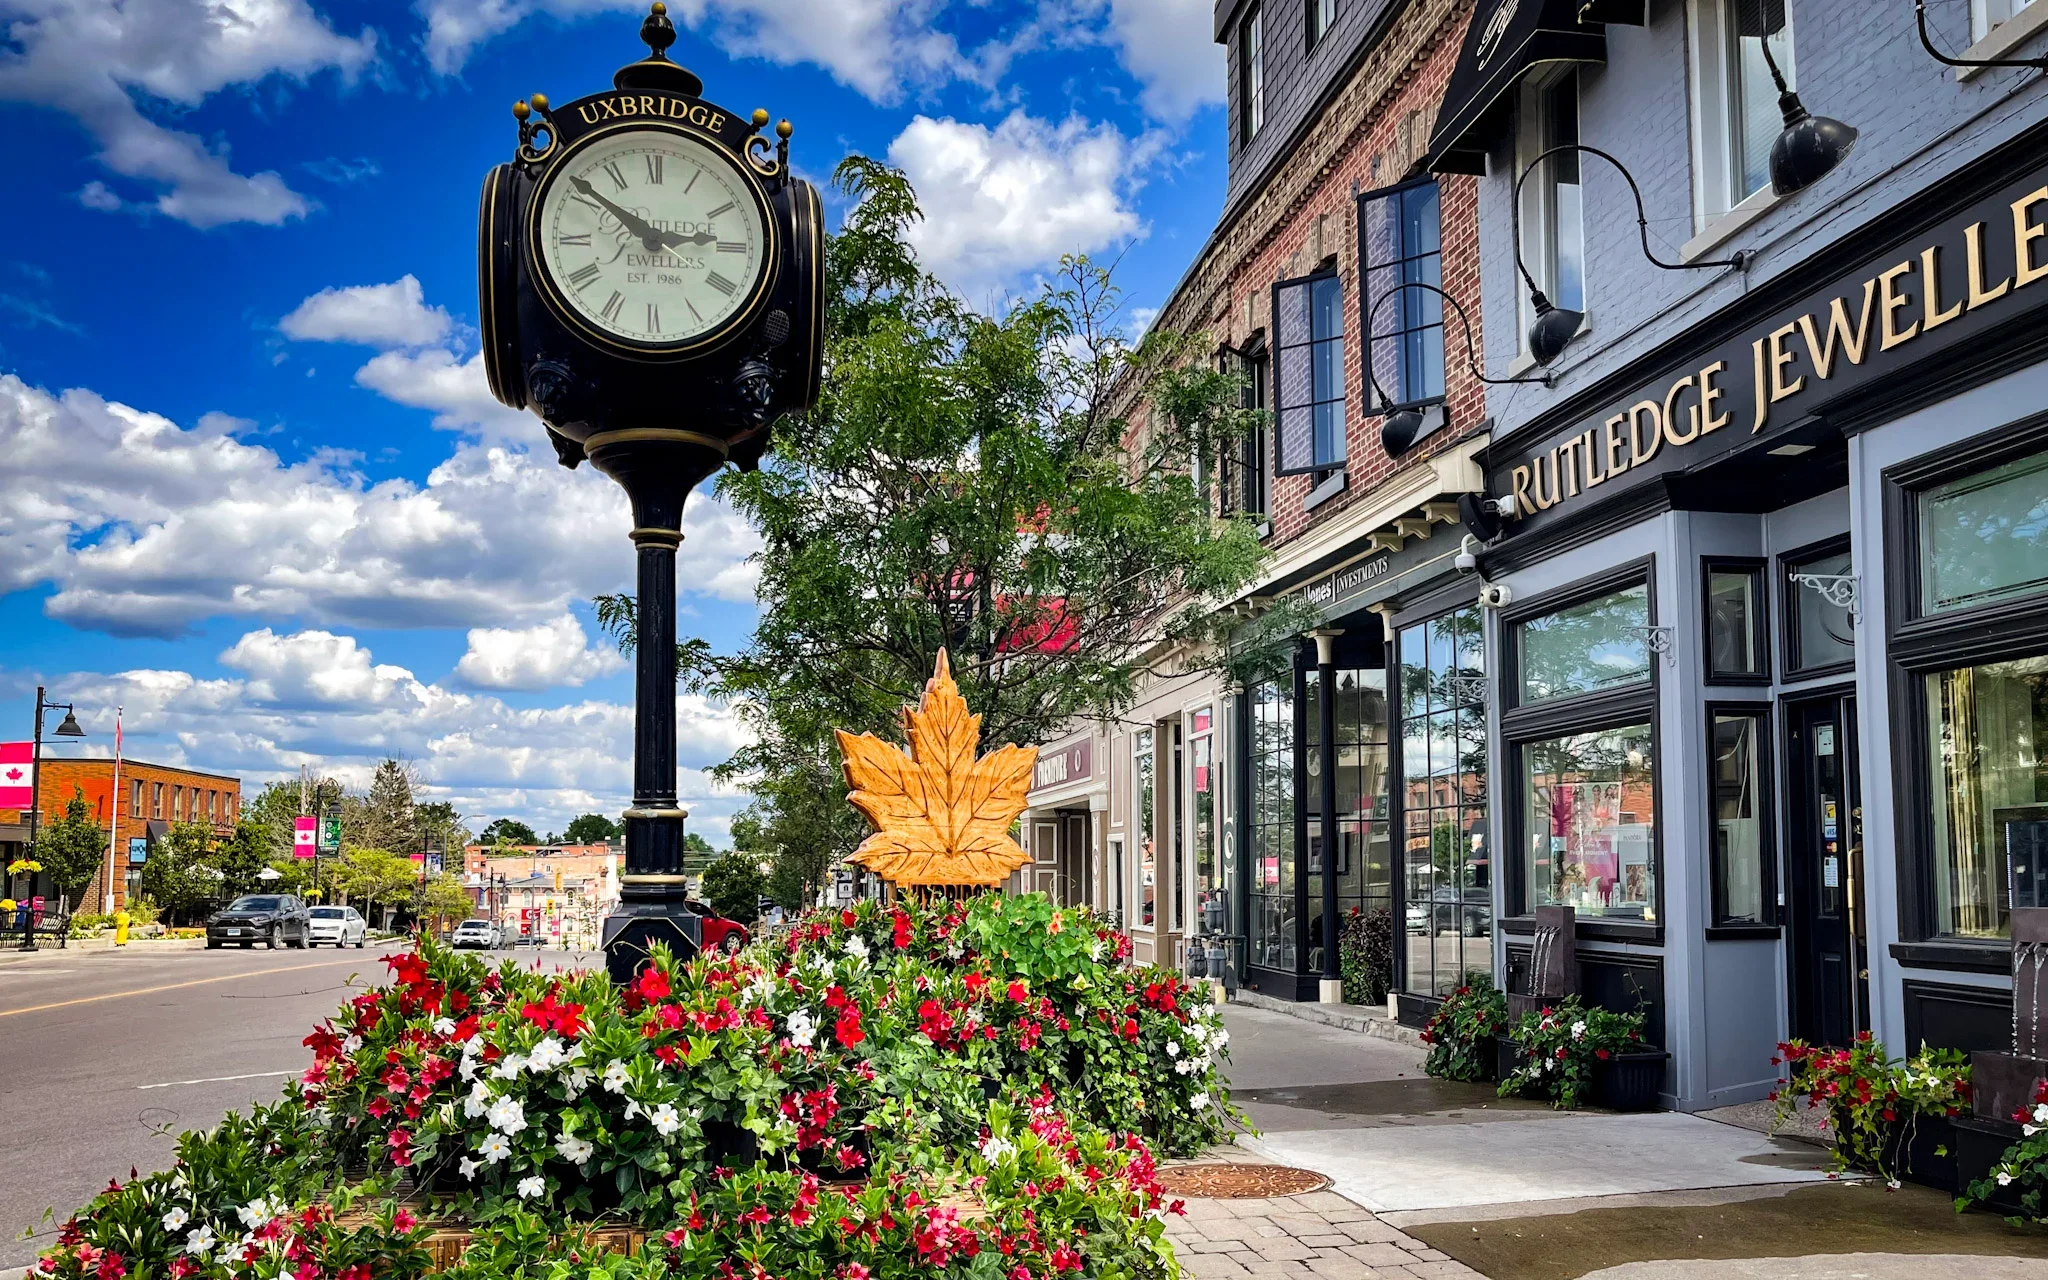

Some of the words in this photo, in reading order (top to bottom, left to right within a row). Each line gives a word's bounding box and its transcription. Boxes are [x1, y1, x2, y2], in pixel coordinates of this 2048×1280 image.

[578, 95, 726, 134] UXBRIDGE
[627, 273, 651, 284] EST.
[657, 274, 682, 285] 1986
[1512, 360, 1731, 519] RUTLEDGE
[1752, 186, 2048, 434] JEWELLE
[1336, 556, 1388, 594] INVESTMENTS
